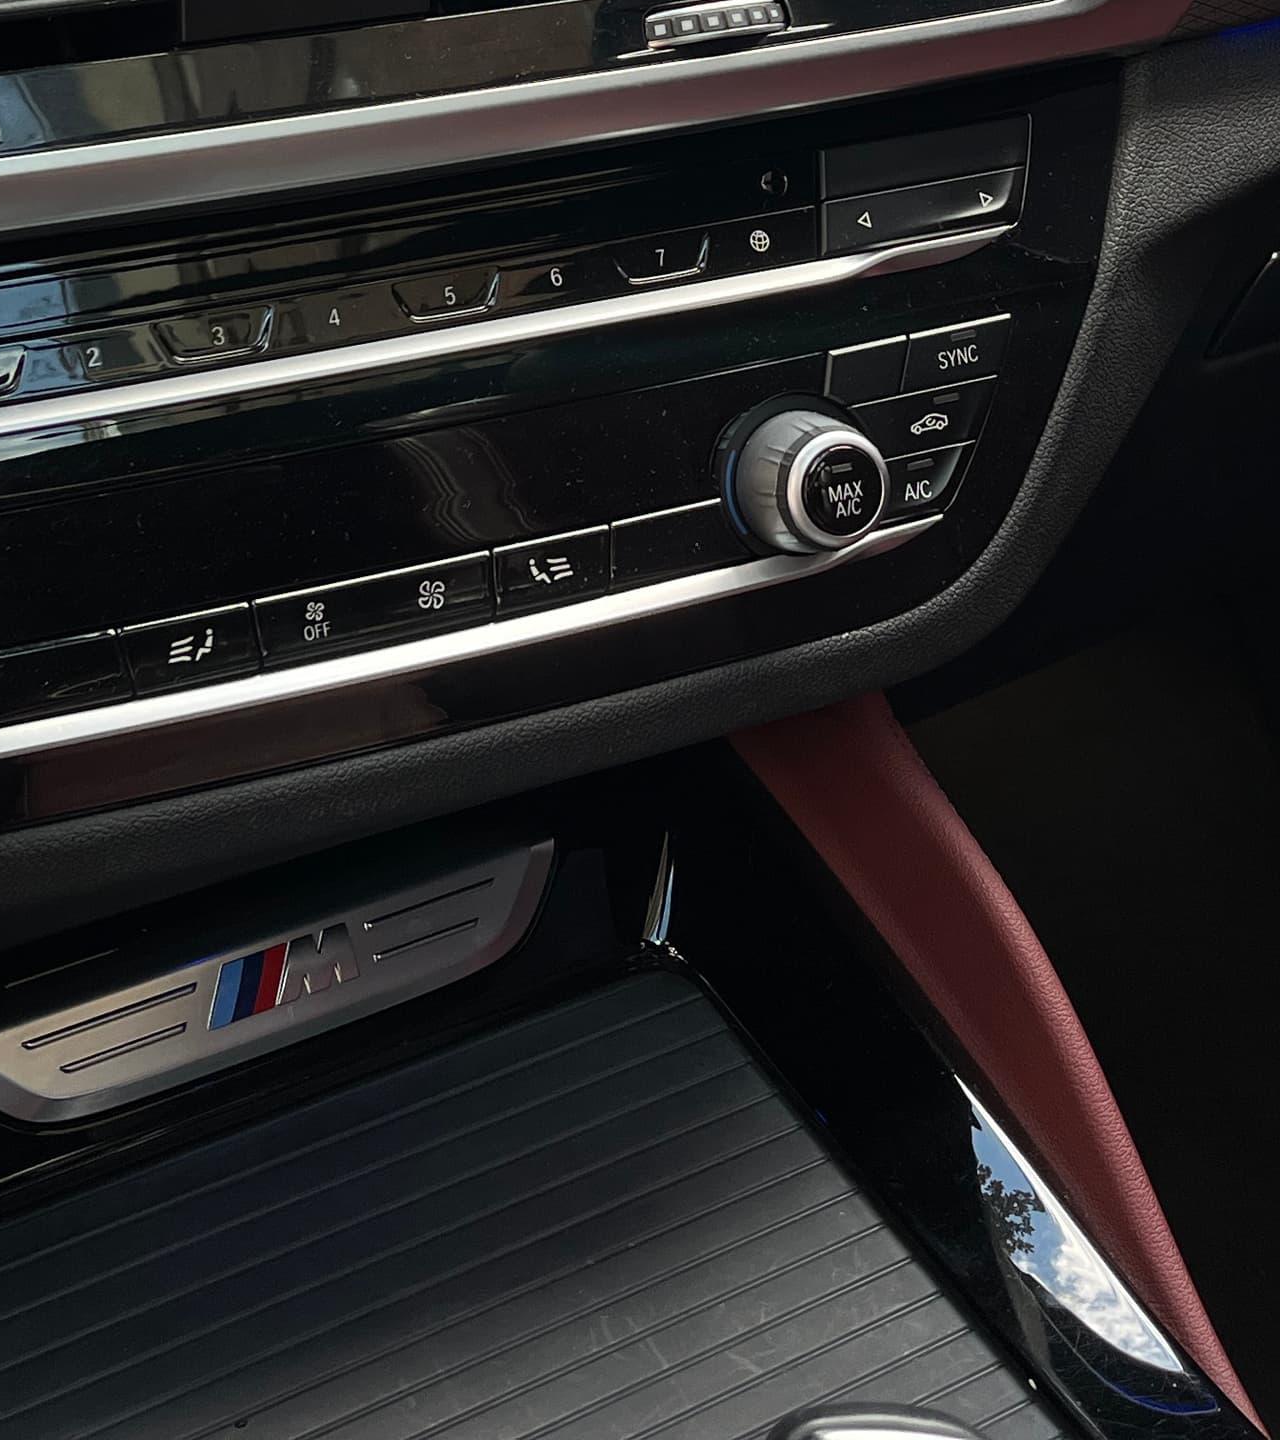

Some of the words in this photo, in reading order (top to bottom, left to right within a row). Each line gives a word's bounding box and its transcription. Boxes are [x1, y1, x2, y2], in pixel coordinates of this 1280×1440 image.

[86, 348, 102, 368] 2
[212, 326, 225, 346] 3
[328, 308, 341, 327] 4
[444, 286, 456, 306] 5
[550, 266, 563, 287] 6
[655, 249, 665, 266] 7
[938, 345, 979, 369] SYNC
[828, 480, 864, 503] MAX
[904, 480, 932, 501] A/C
[835, 498, 862, 519] A/C
[303, 621, 331, 641] OFF
